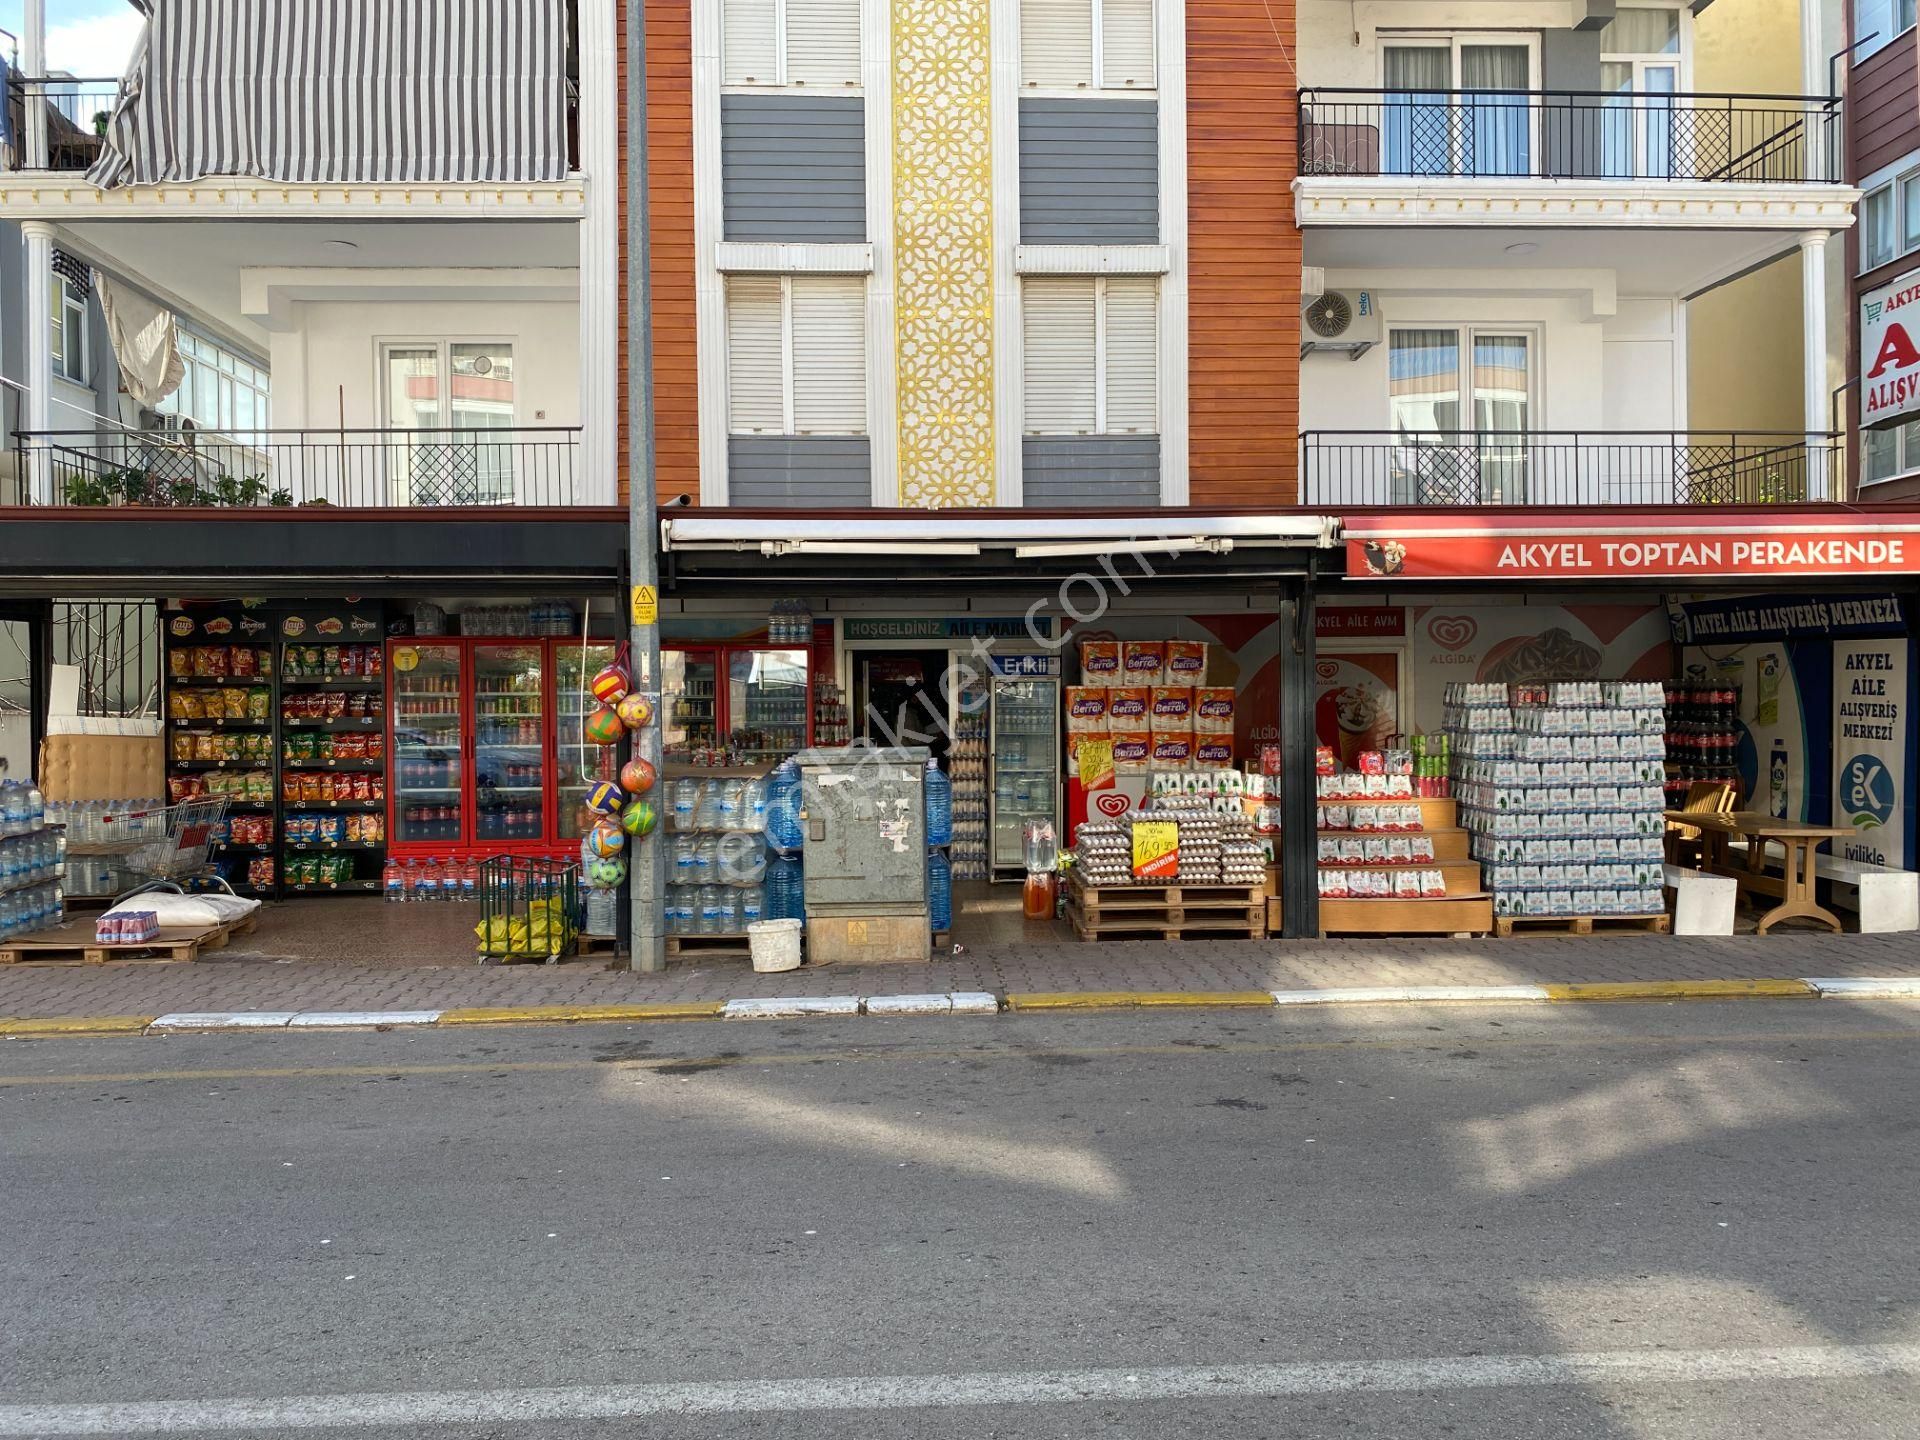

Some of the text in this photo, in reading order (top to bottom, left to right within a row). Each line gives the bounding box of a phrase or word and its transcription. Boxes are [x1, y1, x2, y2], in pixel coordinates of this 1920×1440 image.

[1497, 540, 1904, 567] AKYEL TOPTAN PERAKENDE
[1693, 592, 1903, 635] AKYEL AİLE ALIŞVERİŞ MERKEZİ
[1316, 614, 1398, 628] KYEL AİLE AVM
[850, 619, 941, 638] HOŞGELDİNİZ
[951, 619, 982, 637] AİLE
[1004, 658, 1047, 674] Erikli
[1088, 660, 1116, 670] Berrak
[1128, 658, 1159, 668] Berrak
[1172, 660, 1201, 669] Berrak
[1845, 653, 1893, 670] AKYEL
[1851, 675, 1886, 695] AİLE
[1072, 703, 1104, 714] Berrak
[1113, 702, 1144, 714] Berrak
[1155, 702, 1187, 713] Berrak
[1201, 704, 1231, 714] Berrak
[1840, 700, 1897, 723] ALIŞVERİŞ
[1843, 723, 1893, 740] MERKEZİ
[1114, 747, 1145, 757] Berrak
[1155, 747, 1187, 757] Berrak
[1198, 748, 1229, 759] Berrak
[1141, 854, 1176, 875] İNDİRİM
